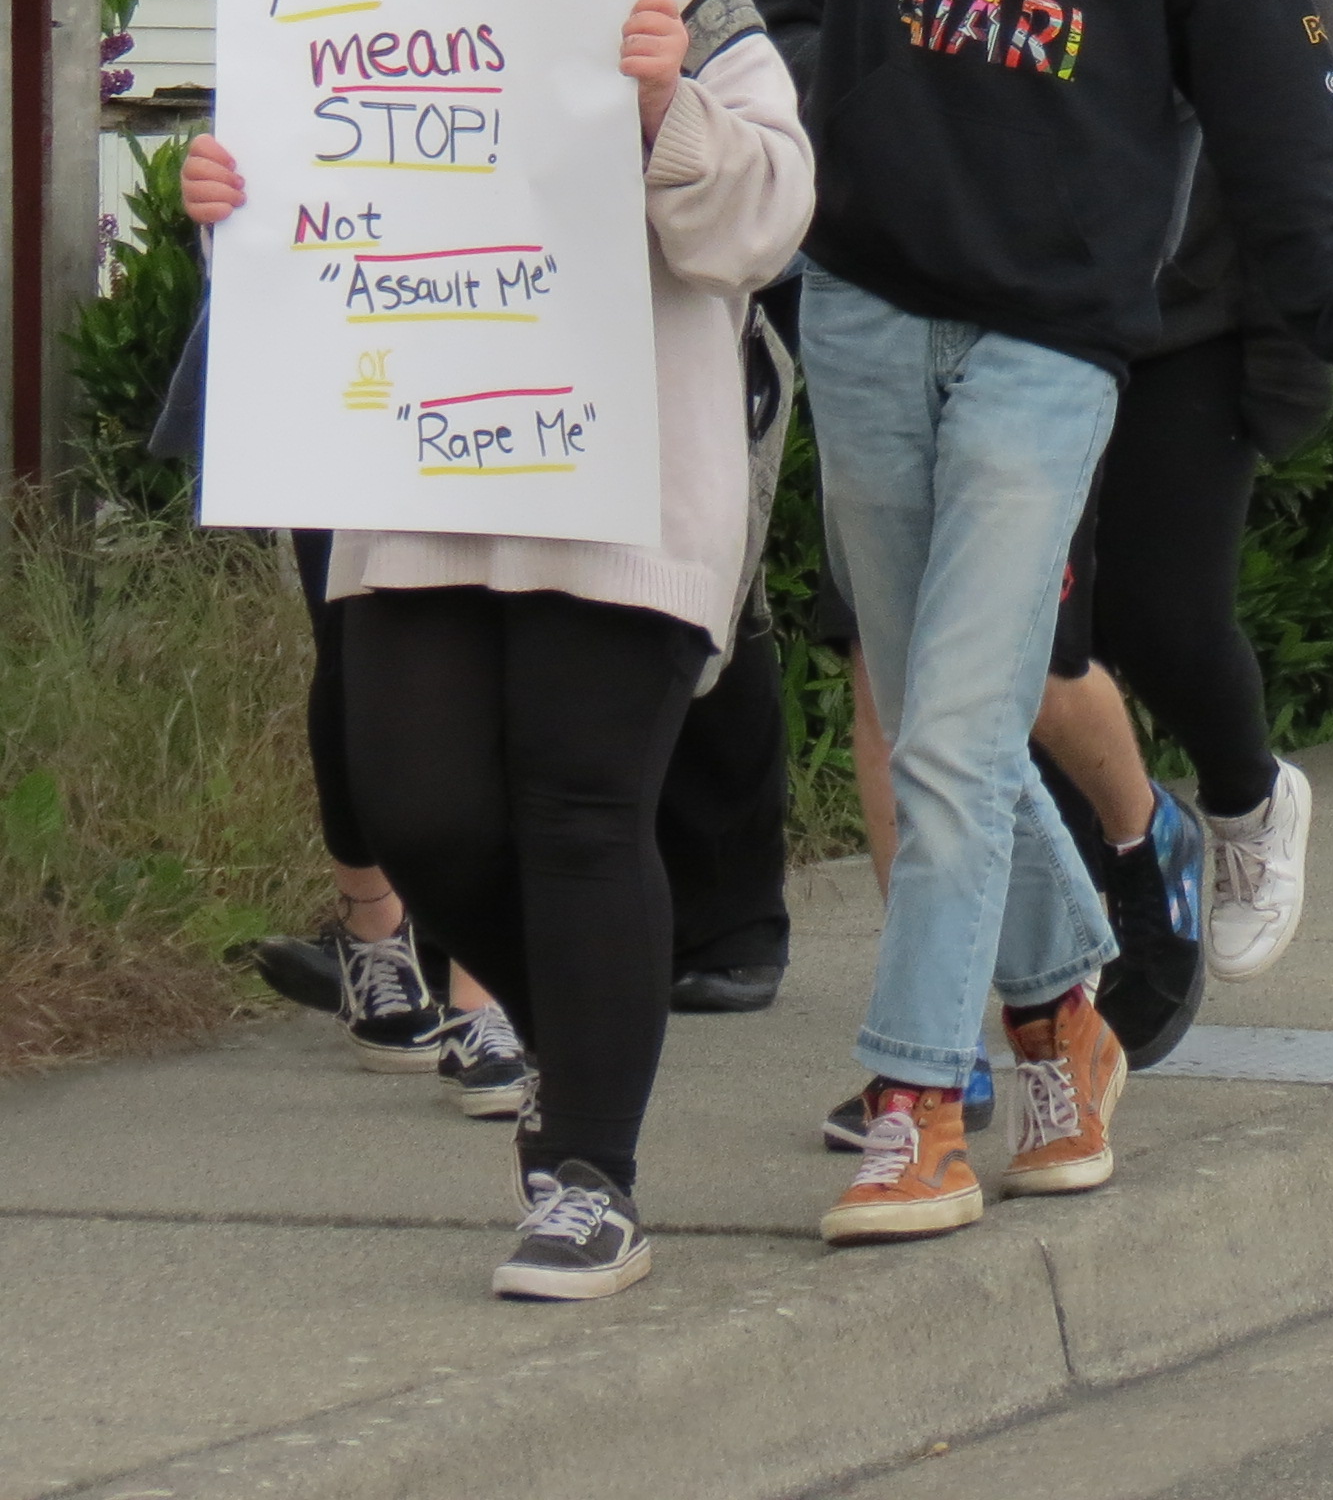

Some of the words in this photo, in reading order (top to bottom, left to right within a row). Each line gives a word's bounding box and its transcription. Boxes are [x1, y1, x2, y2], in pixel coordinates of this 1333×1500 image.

[309, 22, 507, 88] means
[313, 96, 501, 166] STOP!
[293, 201, 383, 247] Not
